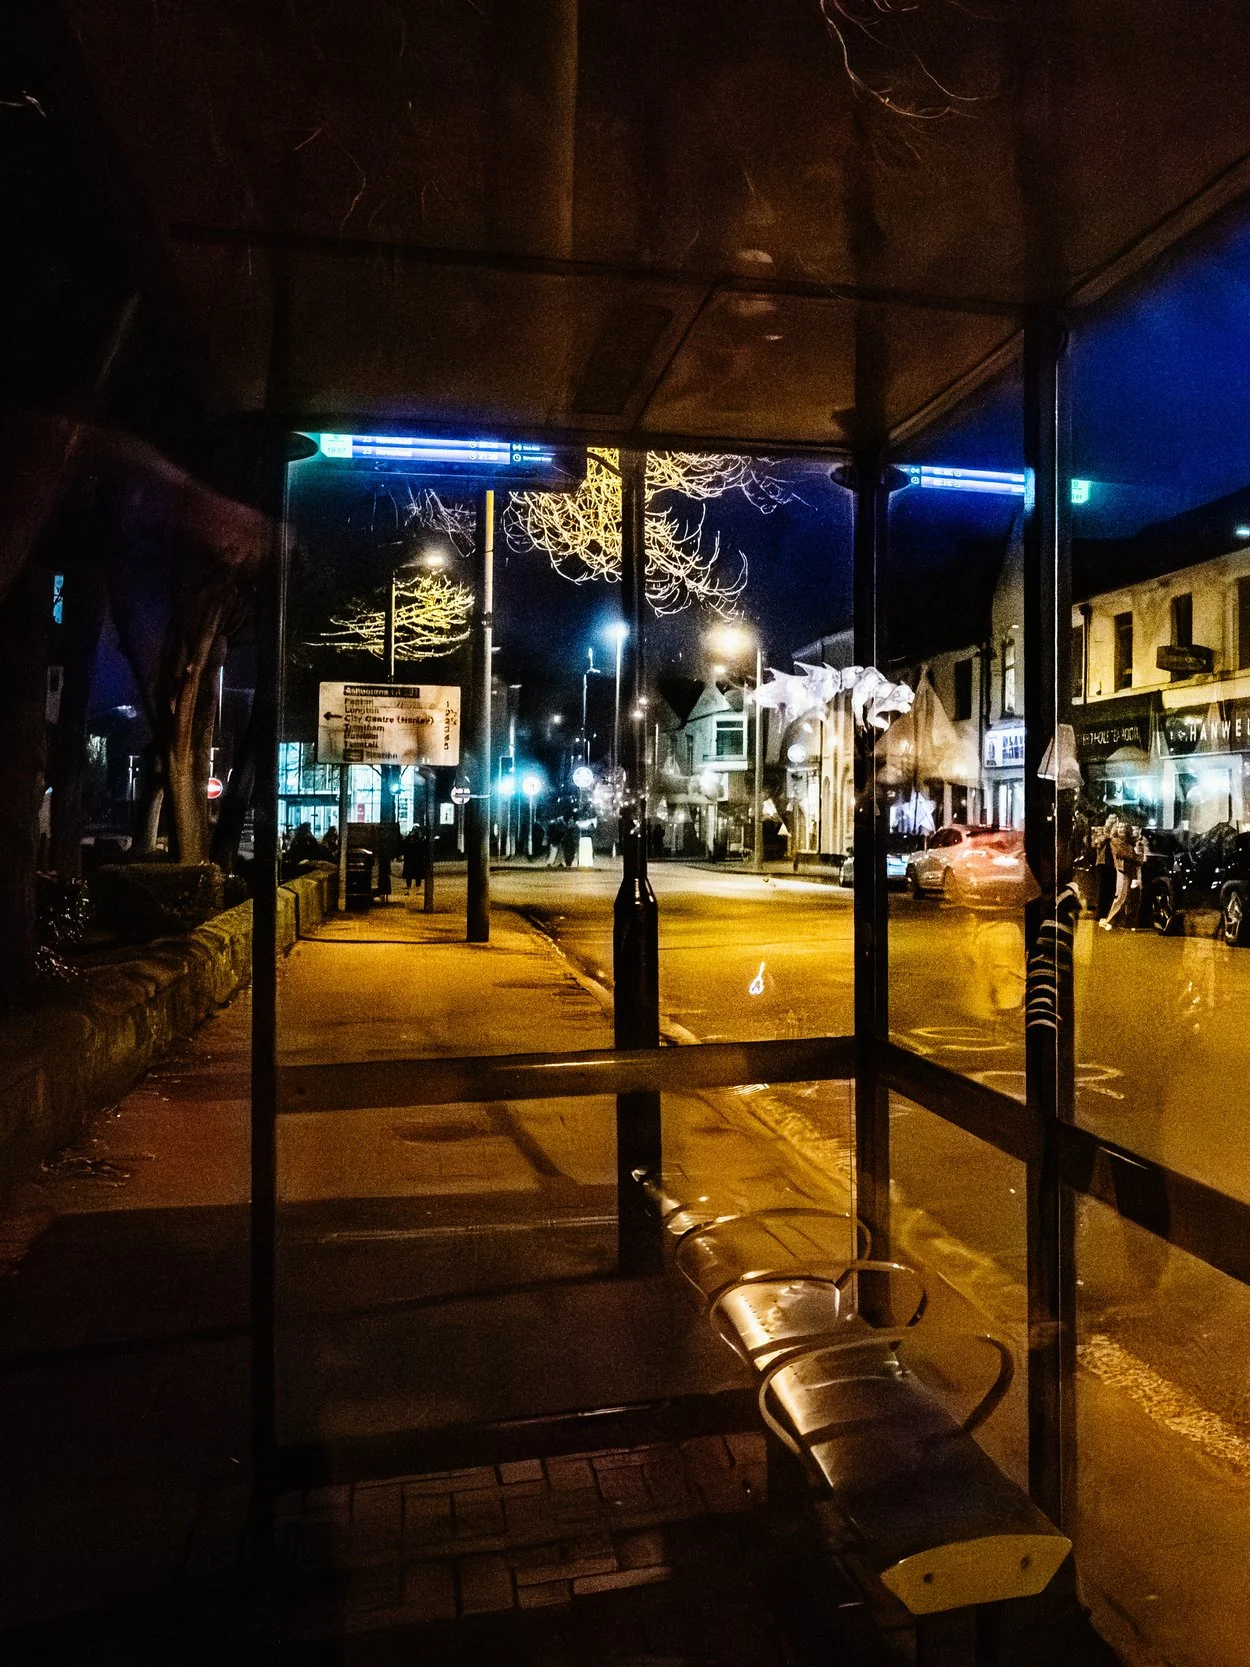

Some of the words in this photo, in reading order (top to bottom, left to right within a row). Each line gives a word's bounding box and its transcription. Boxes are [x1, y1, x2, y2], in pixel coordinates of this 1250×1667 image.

[345, 706, 379, 714] Longton
[344, 714, 362, 723] City
[365, 715, 394, 723] Centre
